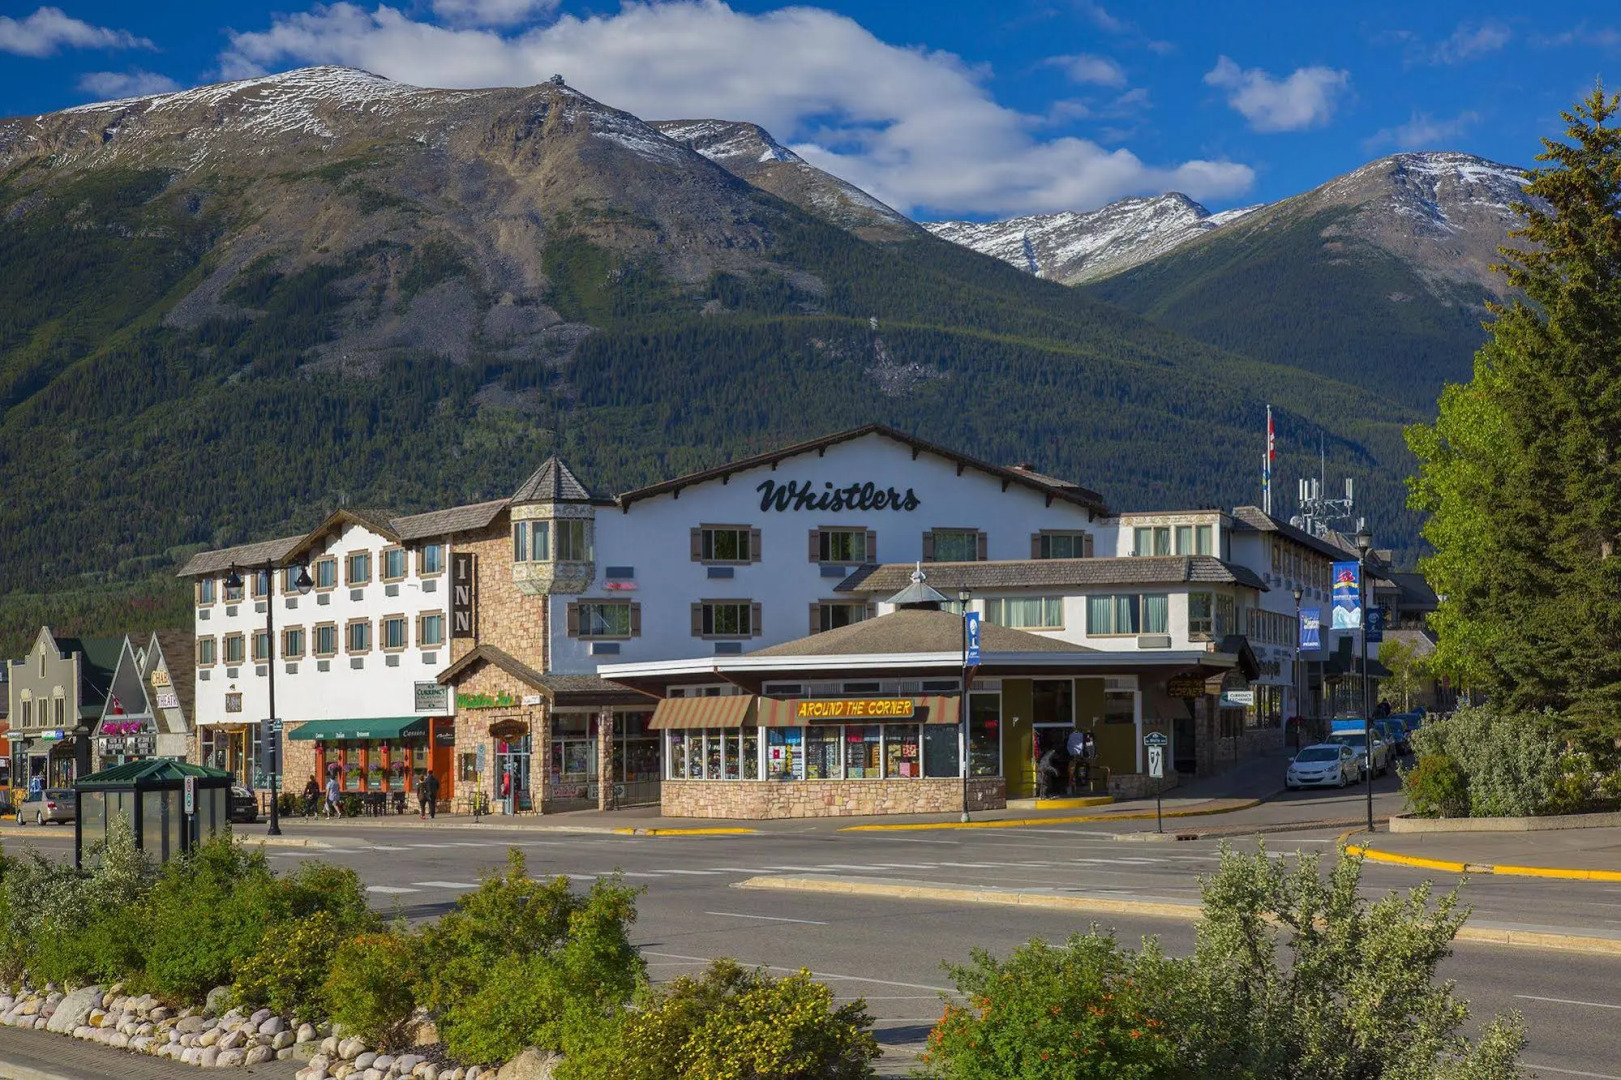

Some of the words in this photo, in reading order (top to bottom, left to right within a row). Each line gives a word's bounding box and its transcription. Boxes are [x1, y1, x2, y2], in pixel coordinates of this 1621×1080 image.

[756, 479, 921, 512] Whistlers
[455, 559, 470, 631] INN
[417, 688, 445, 696] CURRENCY
[798, 702, 843, 717] AROUND
[846, 701, 865, 715] THE
[868, 700, 911, 714] CORNER
